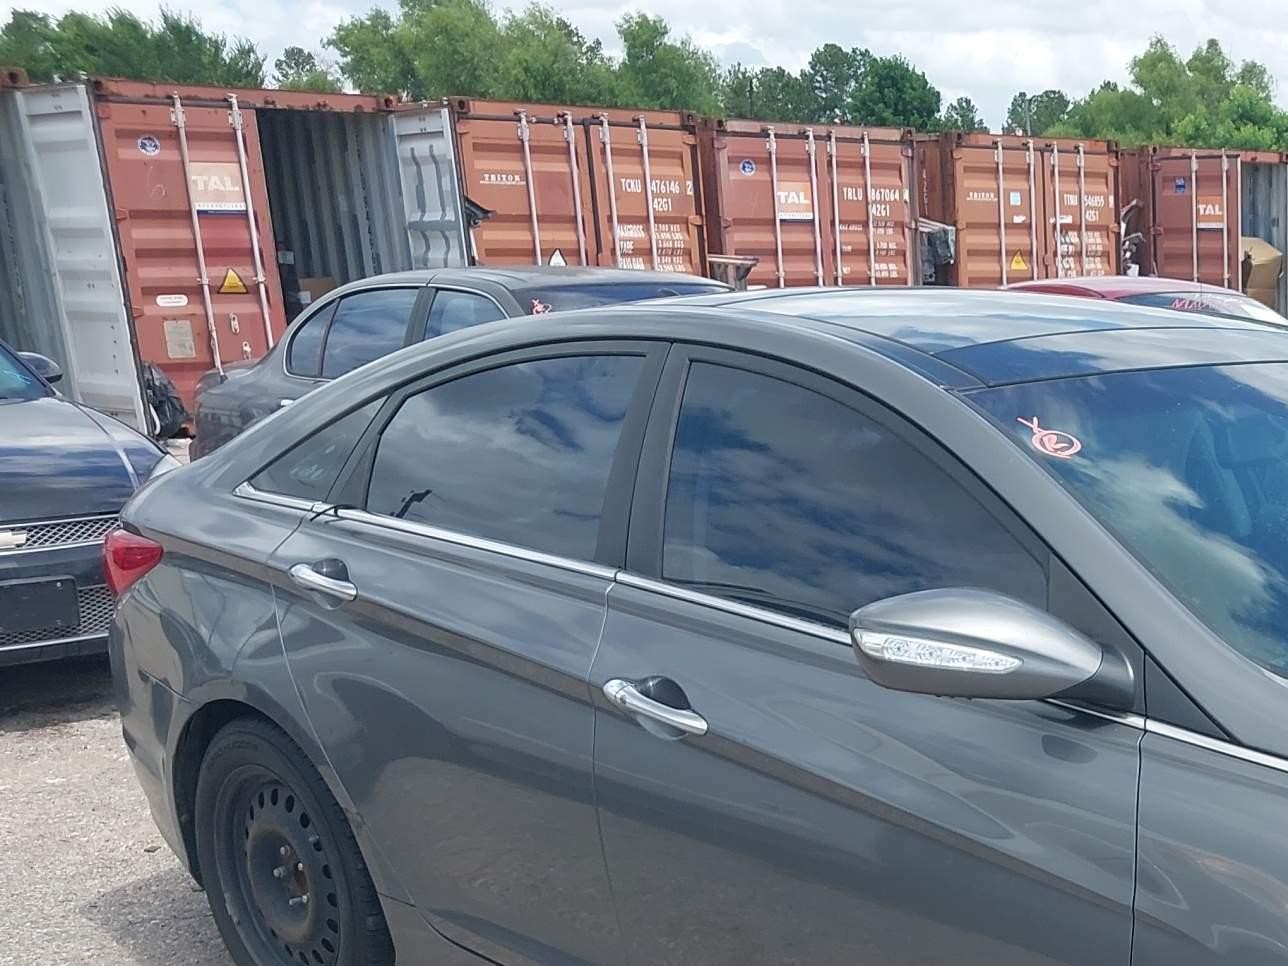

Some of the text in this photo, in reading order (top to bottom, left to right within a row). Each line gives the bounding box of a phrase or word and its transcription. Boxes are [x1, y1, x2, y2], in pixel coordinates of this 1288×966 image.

[192, 176, 239, 191] TAL
[620, 179, 642, 193] TCKU
[651, 180, 680, 194] 476146
[777, 191, 811, 204] TAL
[843, 187, 863, 201] TRLU
[653, 197, 672, 212] 42G1
[871, 203, 890, 217] 42G1
[1197, 203, 1223, 216] TAL
